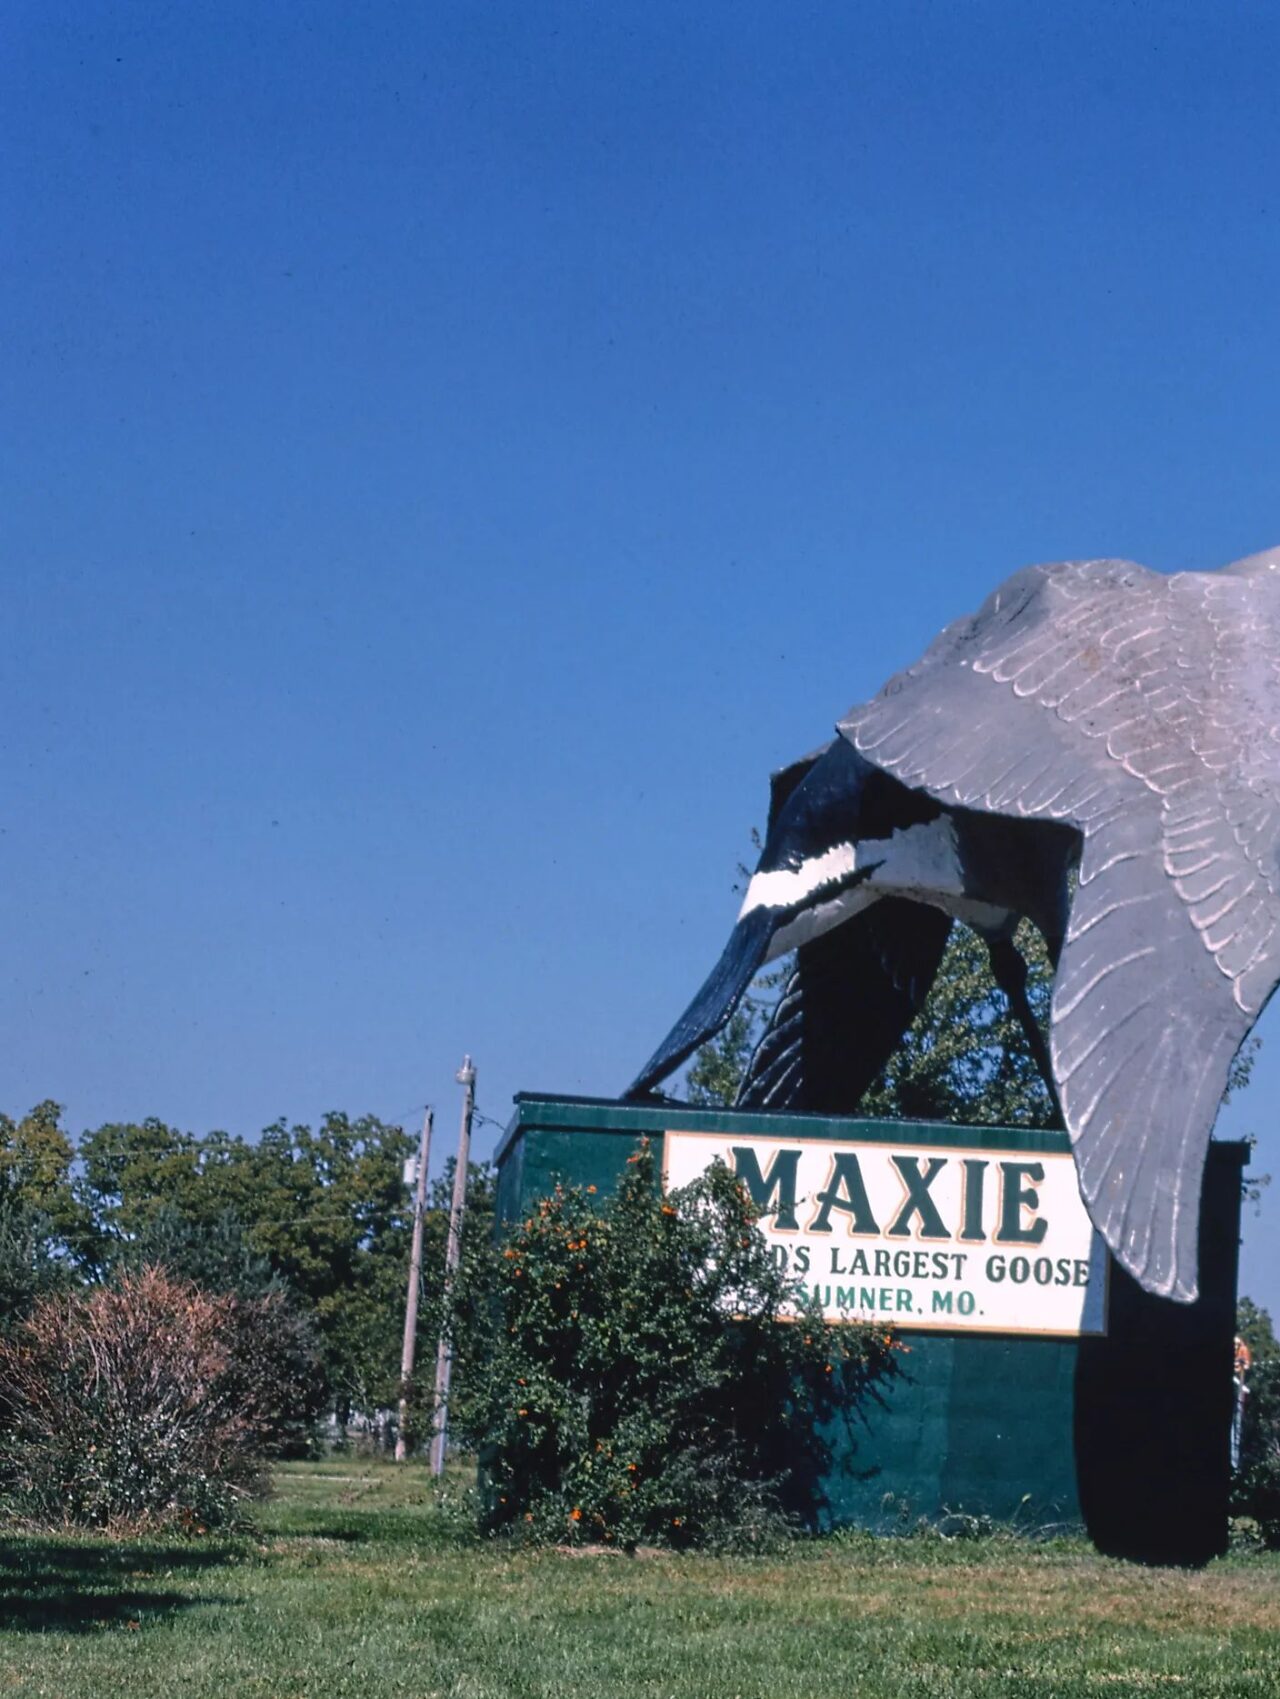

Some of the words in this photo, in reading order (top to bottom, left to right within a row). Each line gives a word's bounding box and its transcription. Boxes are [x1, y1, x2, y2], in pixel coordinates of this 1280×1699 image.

[727, 1146, 1049, 1247] MAXIE
[829, 1247, 967, 1280] LARGEST
[985, 1255, 1090, 1286] GOOSE
[795, 1281, 923, 1315] SUMNER,
[931, 1289, 985, 1316] MO.
